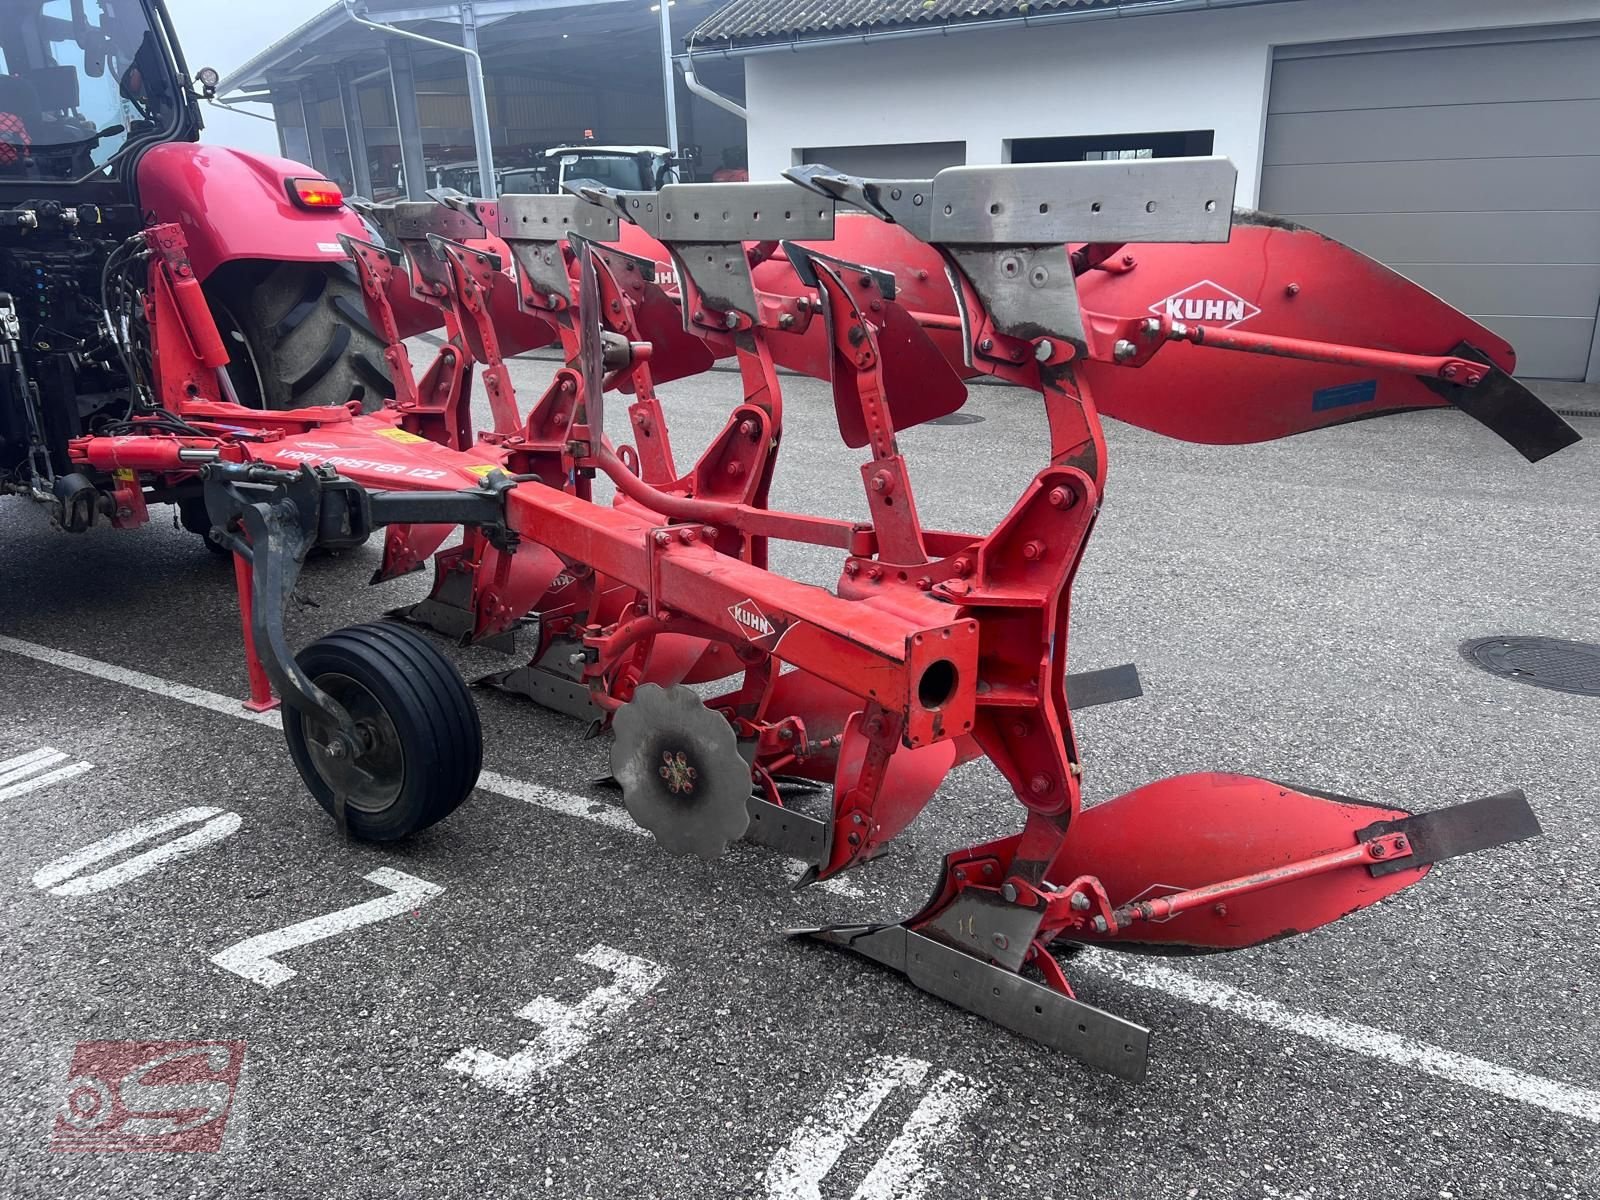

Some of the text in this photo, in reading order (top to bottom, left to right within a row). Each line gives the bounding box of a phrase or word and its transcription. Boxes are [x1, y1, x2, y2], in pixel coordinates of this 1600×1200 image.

[1165, 298, 1246, 321] KUHN
[275, 448, 447, 480] VARI-MASTER 122
[734, 605, 768, 635] KUHN
